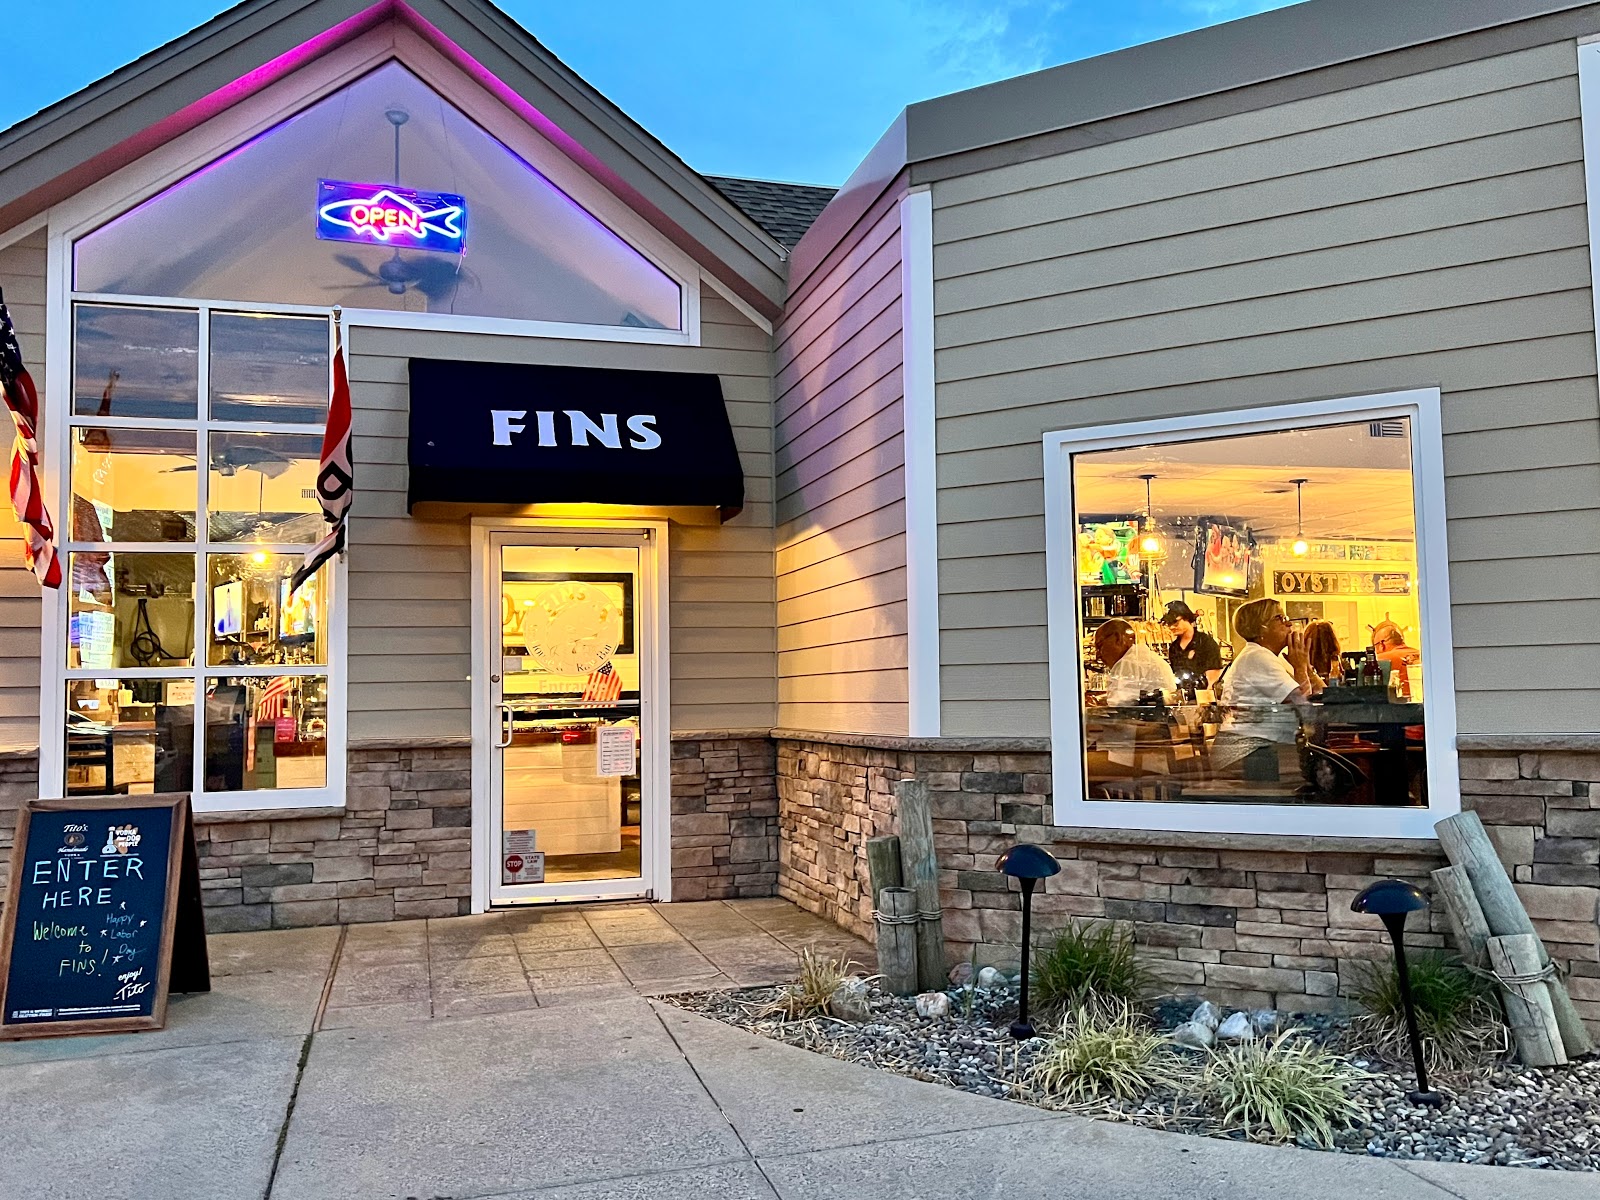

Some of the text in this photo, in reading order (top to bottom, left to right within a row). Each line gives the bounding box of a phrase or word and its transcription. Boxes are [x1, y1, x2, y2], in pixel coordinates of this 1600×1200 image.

[350, 205, 419, 229] OPEN
[490, 409, 662, 450] FINS
[1281, 572, 1376, 593] OYSTERS
[538, 585, 587, 612] FINS
[63, 823, 88, 833] Tito's
[32, 857, 144, 884] ENTER
[42, 886, 112, 909] HERE
[33, 920, 89, 940] Welcome
[106, 913, 135, 927] Happy
[110, 929, 138, 939] Labor
[78, 940, 92, 954] to
[118, 943, 142, 961] Day
[58, 948, 109, 977] FINS!
[117, 967, 143, 983] enjoy!
